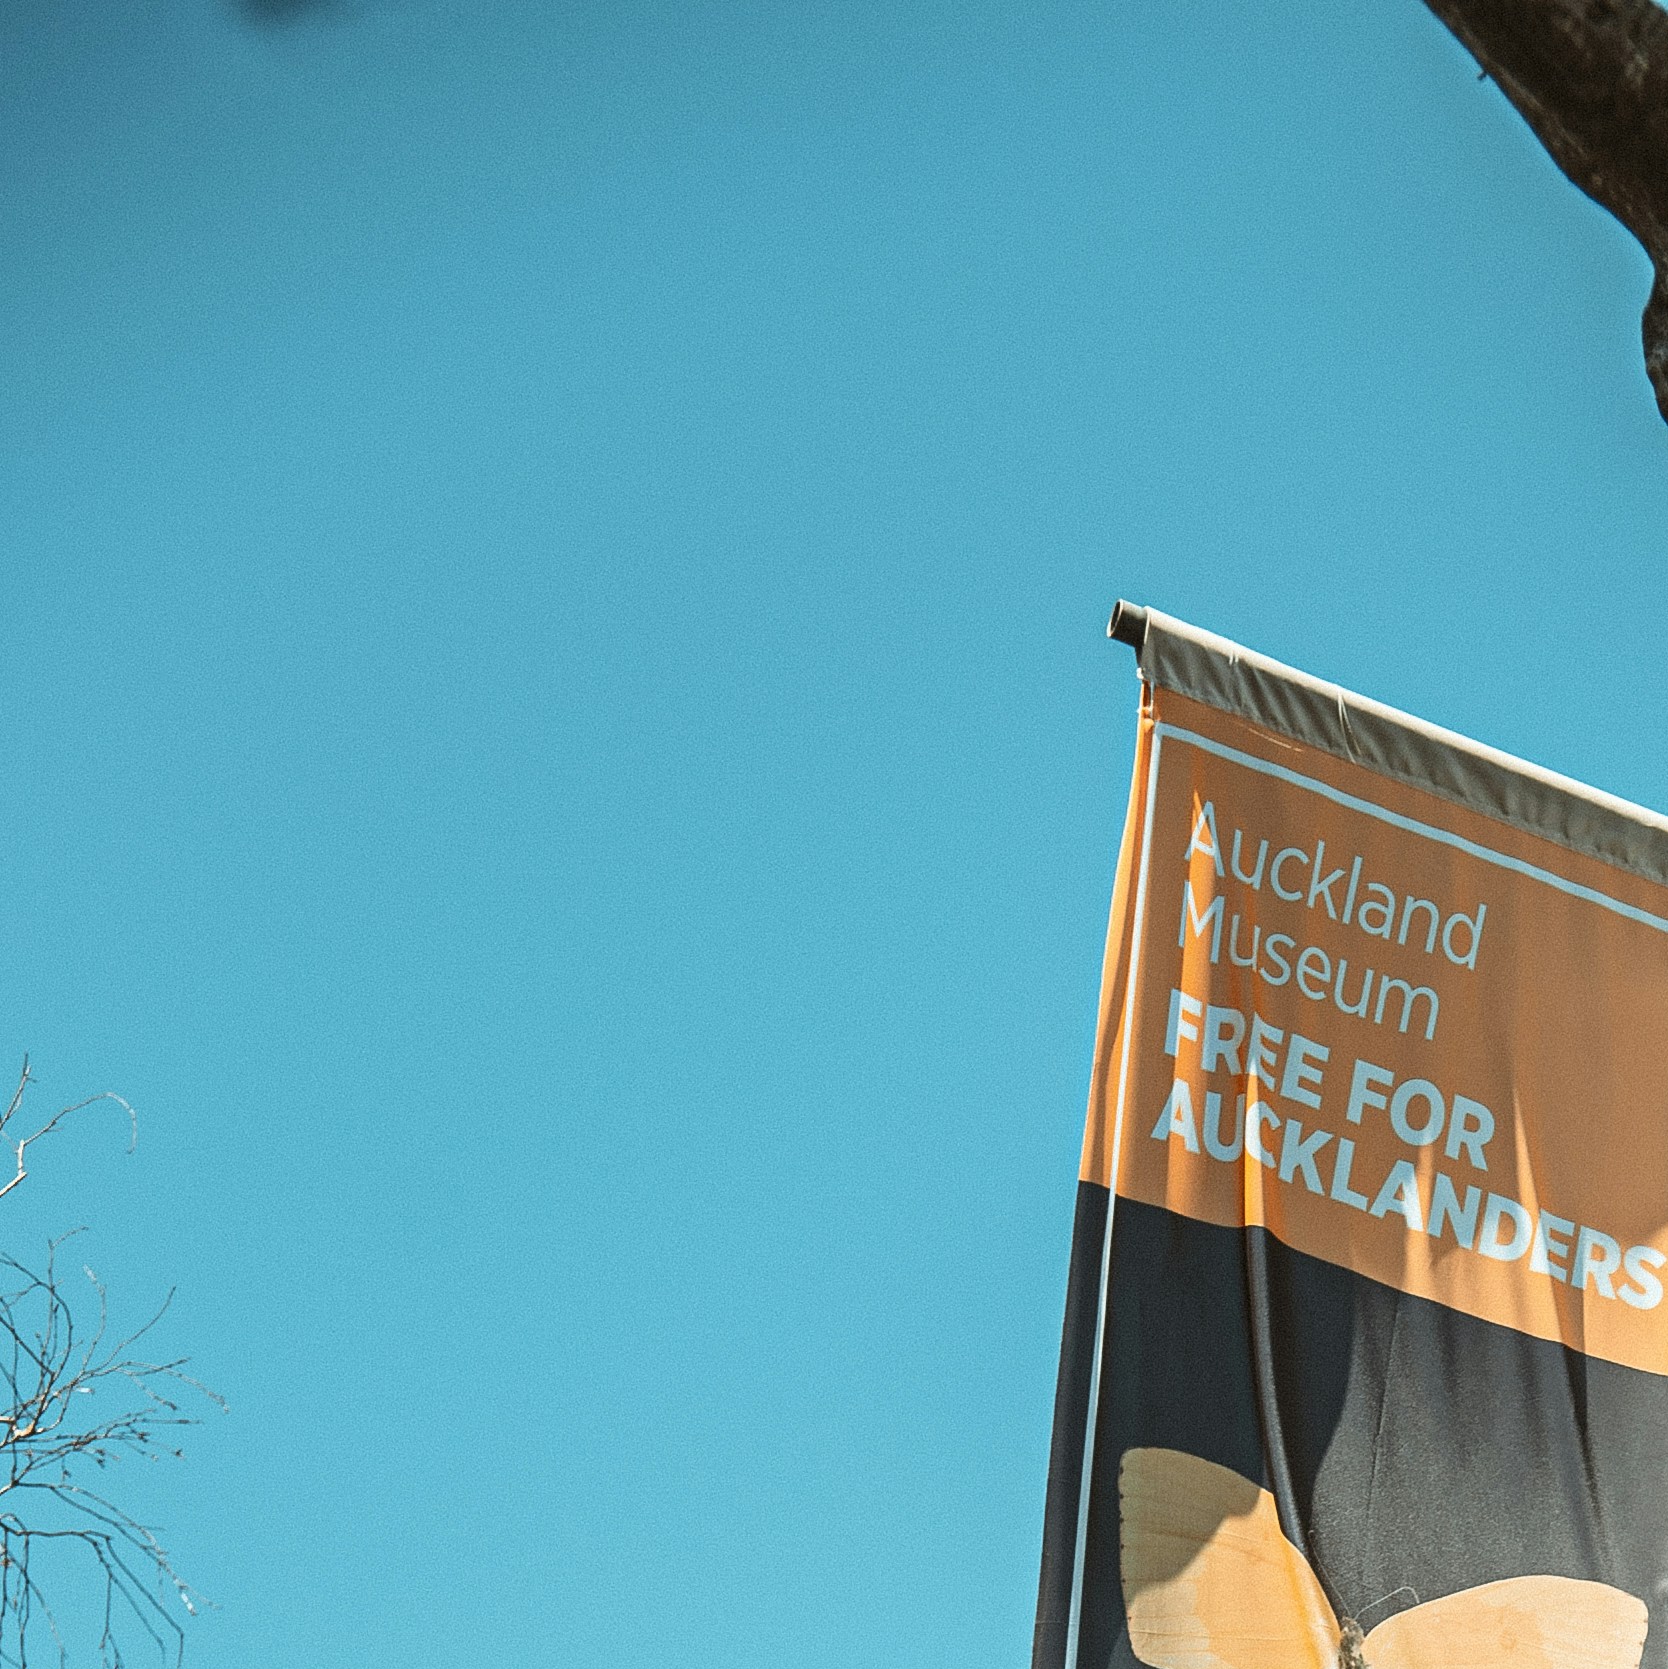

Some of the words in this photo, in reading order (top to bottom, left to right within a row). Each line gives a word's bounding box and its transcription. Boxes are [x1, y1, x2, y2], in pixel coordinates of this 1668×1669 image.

[1178, 881, 1440, 1041] Museum
[1184, 800, 1486, 971] Auckland
[1164, 988, 1330, 1110] FREE
[1346, 1056, 1496, 1172] FOR
[1151, 1078, 1668, 1310] AUCKLANDERS
